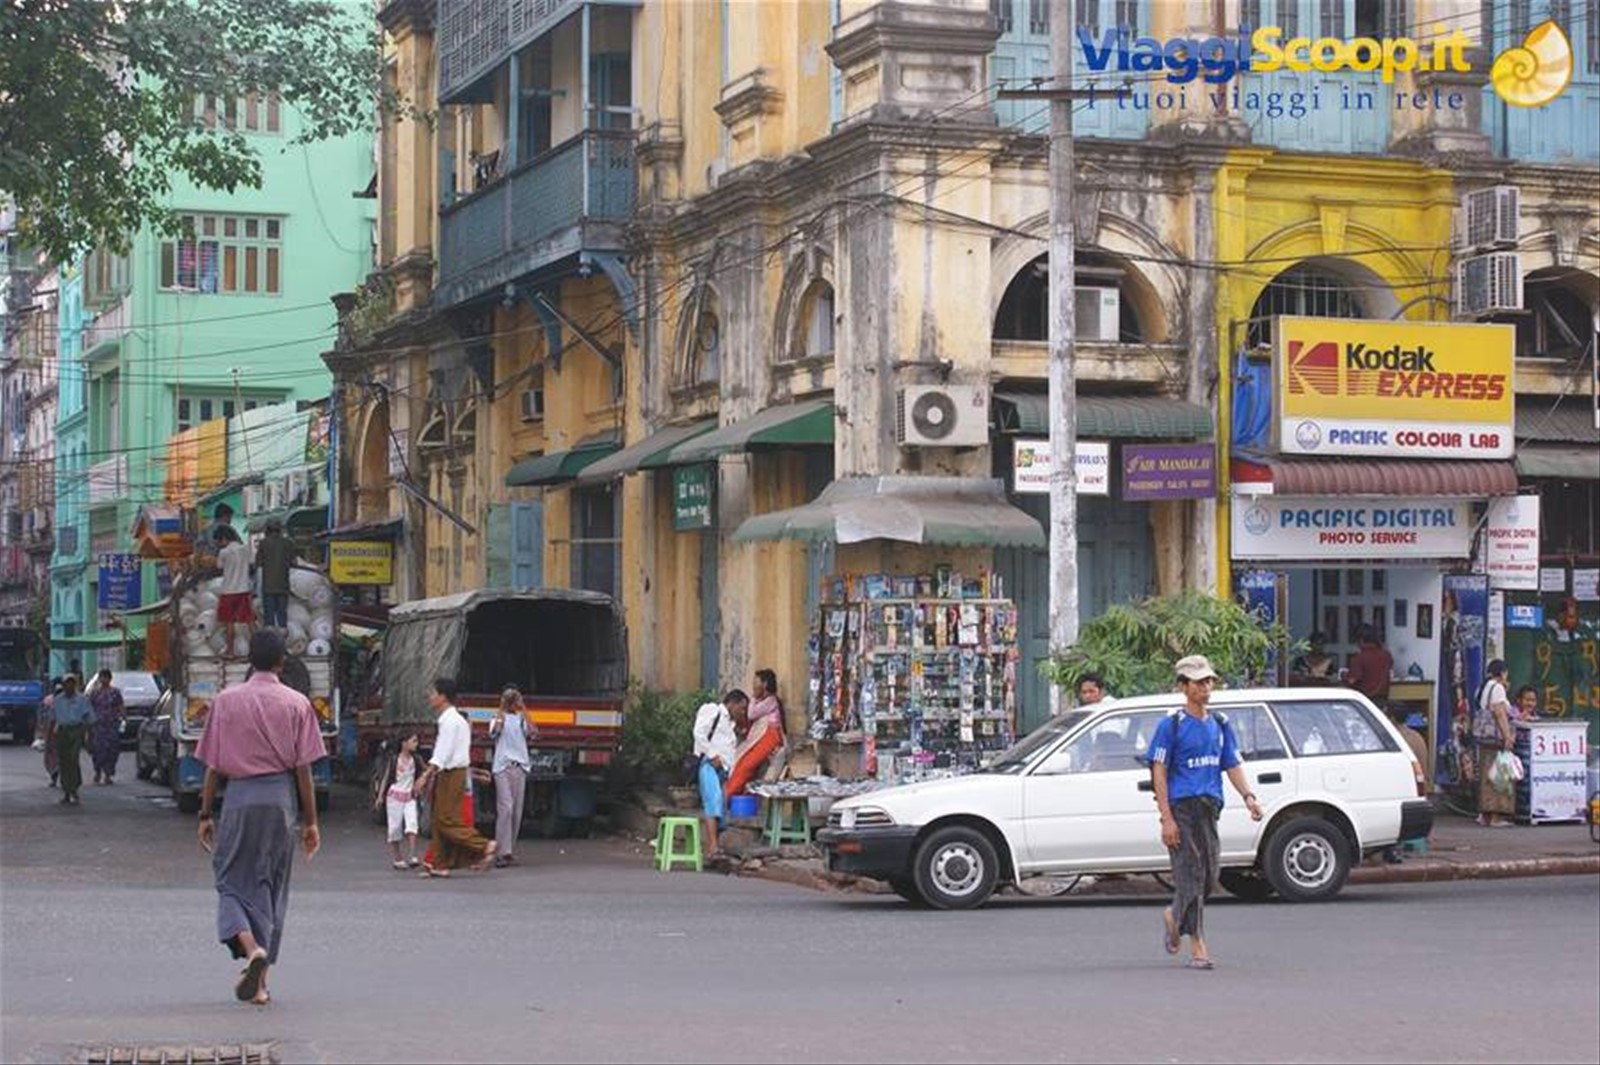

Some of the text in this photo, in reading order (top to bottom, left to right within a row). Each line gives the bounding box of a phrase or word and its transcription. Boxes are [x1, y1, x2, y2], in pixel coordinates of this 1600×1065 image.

[1346, 342, 1436, 373] Kodak
[1376, 370, 1506, 401] EXPRESS
[1329, 428, 1500, 449] PACIFIC COLOUR LAB
[1280, 508, 1456, 528] PACIFIC DIGITAL
[1319, 532, 1418, 544] PHOTO SERVICE
[1535, 735, 1546, 756] 3
[1552, 735, 1570, 755] in
